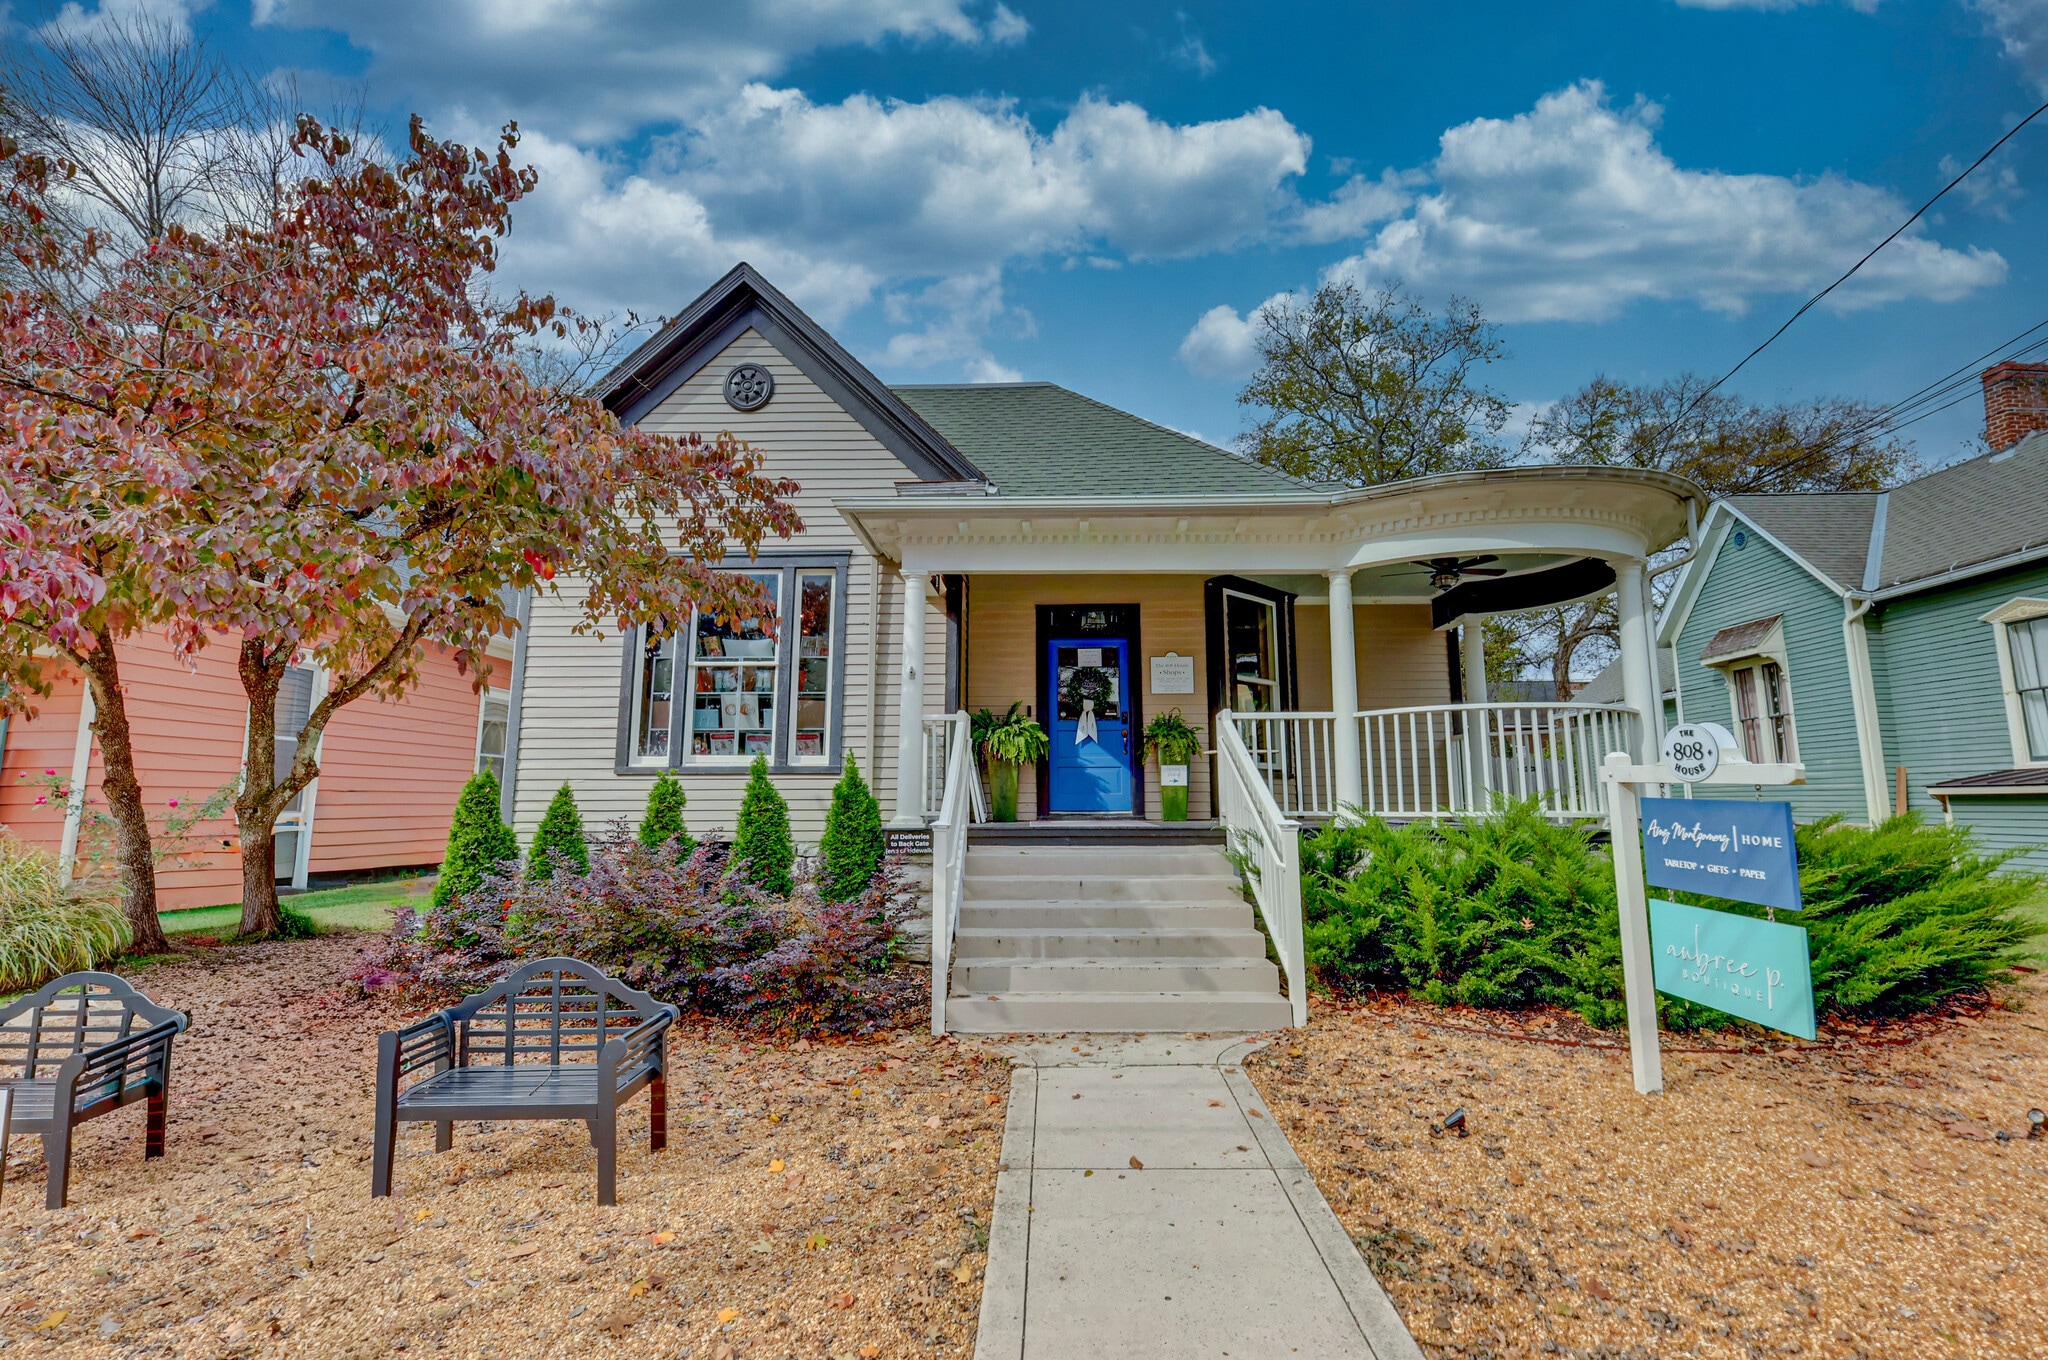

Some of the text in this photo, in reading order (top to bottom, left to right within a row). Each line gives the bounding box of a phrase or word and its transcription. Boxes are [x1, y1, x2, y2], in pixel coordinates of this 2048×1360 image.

[1679, 729, 1694, 737] THE
[1673, 742, 1704, 761] 808
[1674, 763, 1706, 776] HOUSE
[1647, 819, 1783, 852] Amy Montgomery HOME
[1664, 858, 1766, 880] TABLETOP GIFTS PAPER
[1667, 924, 1758, 977] aubree
[1682, 969, 1763, 1002] BOUTIQUE
